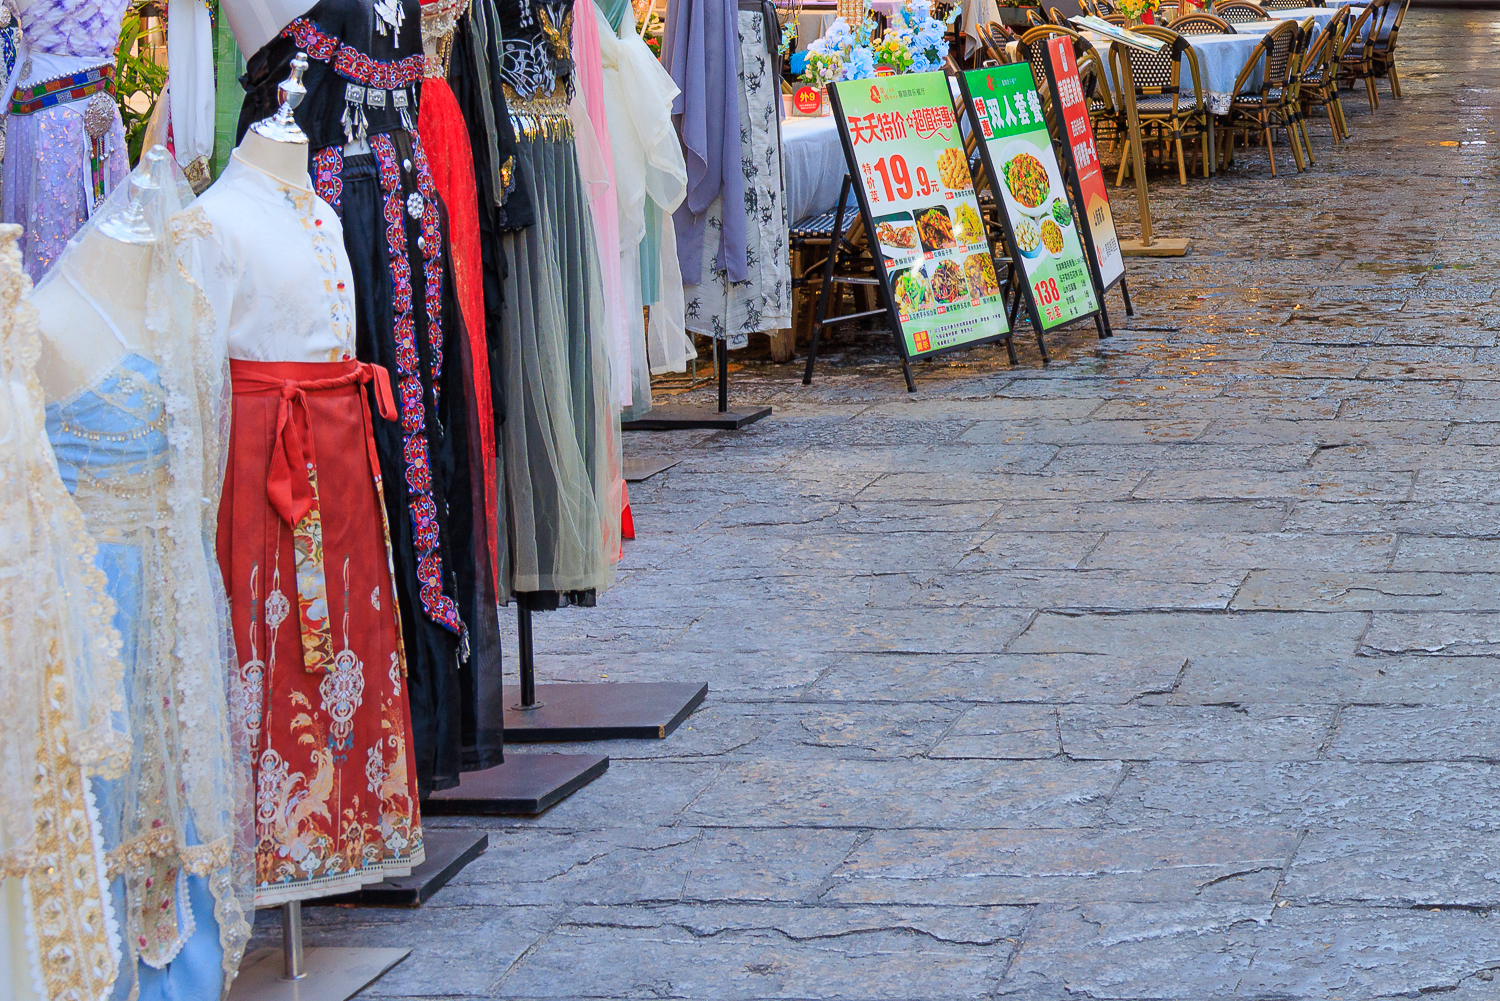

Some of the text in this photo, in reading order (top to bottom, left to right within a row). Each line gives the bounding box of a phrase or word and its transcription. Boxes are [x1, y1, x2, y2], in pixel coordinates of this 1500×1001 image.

[847, 105, 953, 147] 天天特价 超值特惠
[974, 98, 993, 137] 特惠
[986, 89, 1044, 130] 双人套餐
[861, 163, 880, 203] 特价菜
[1034, 277, 1060, 307] 138
